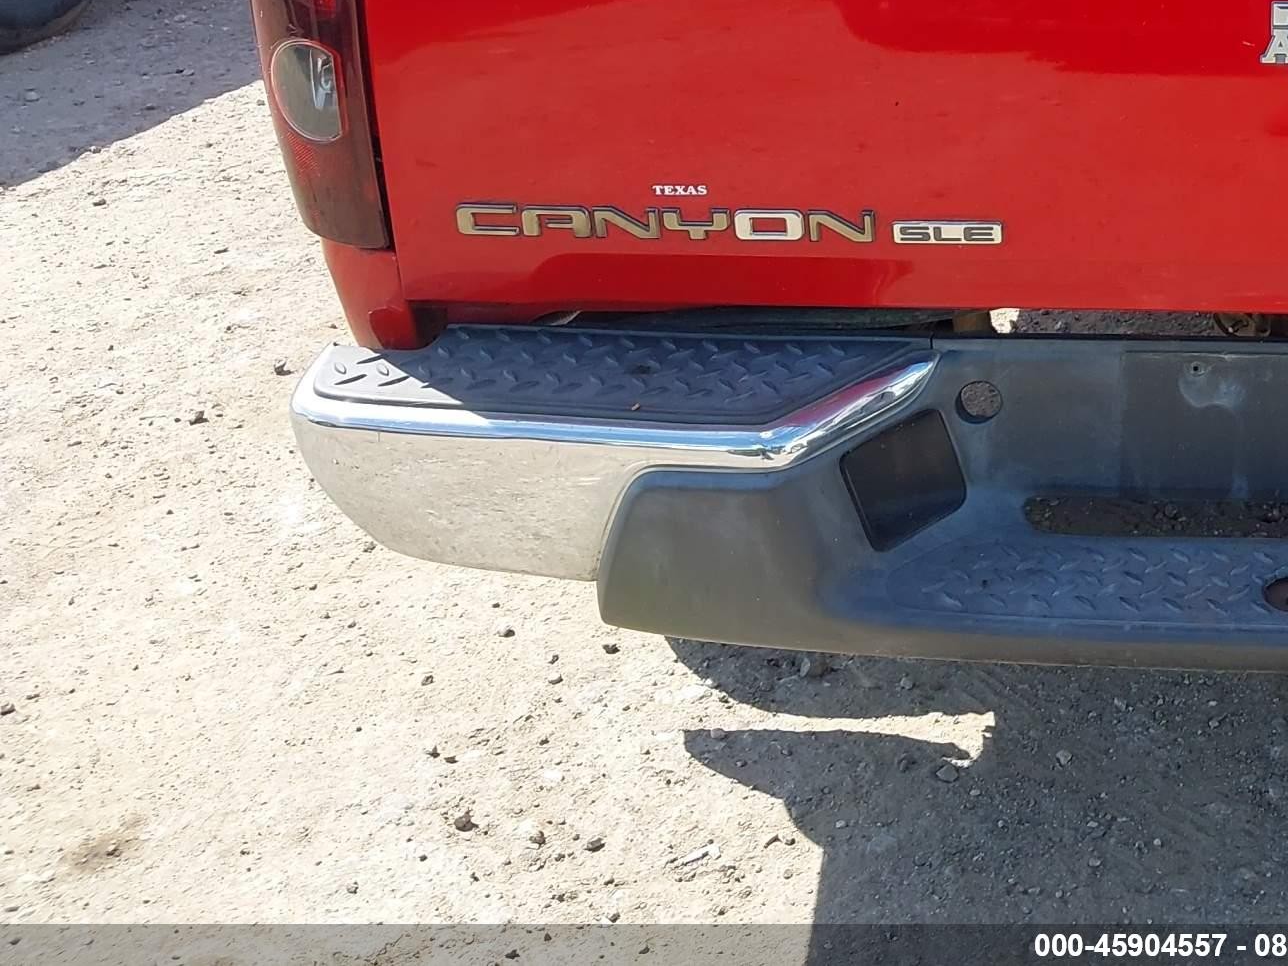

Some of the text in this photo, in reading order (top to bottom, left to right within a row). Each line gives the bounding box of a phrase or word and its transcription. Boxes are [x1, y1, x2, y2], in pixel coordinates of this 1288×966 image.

[652, 184, 708, 196] TEXAS
[453, 200, 997, 245] CANYON SLE
